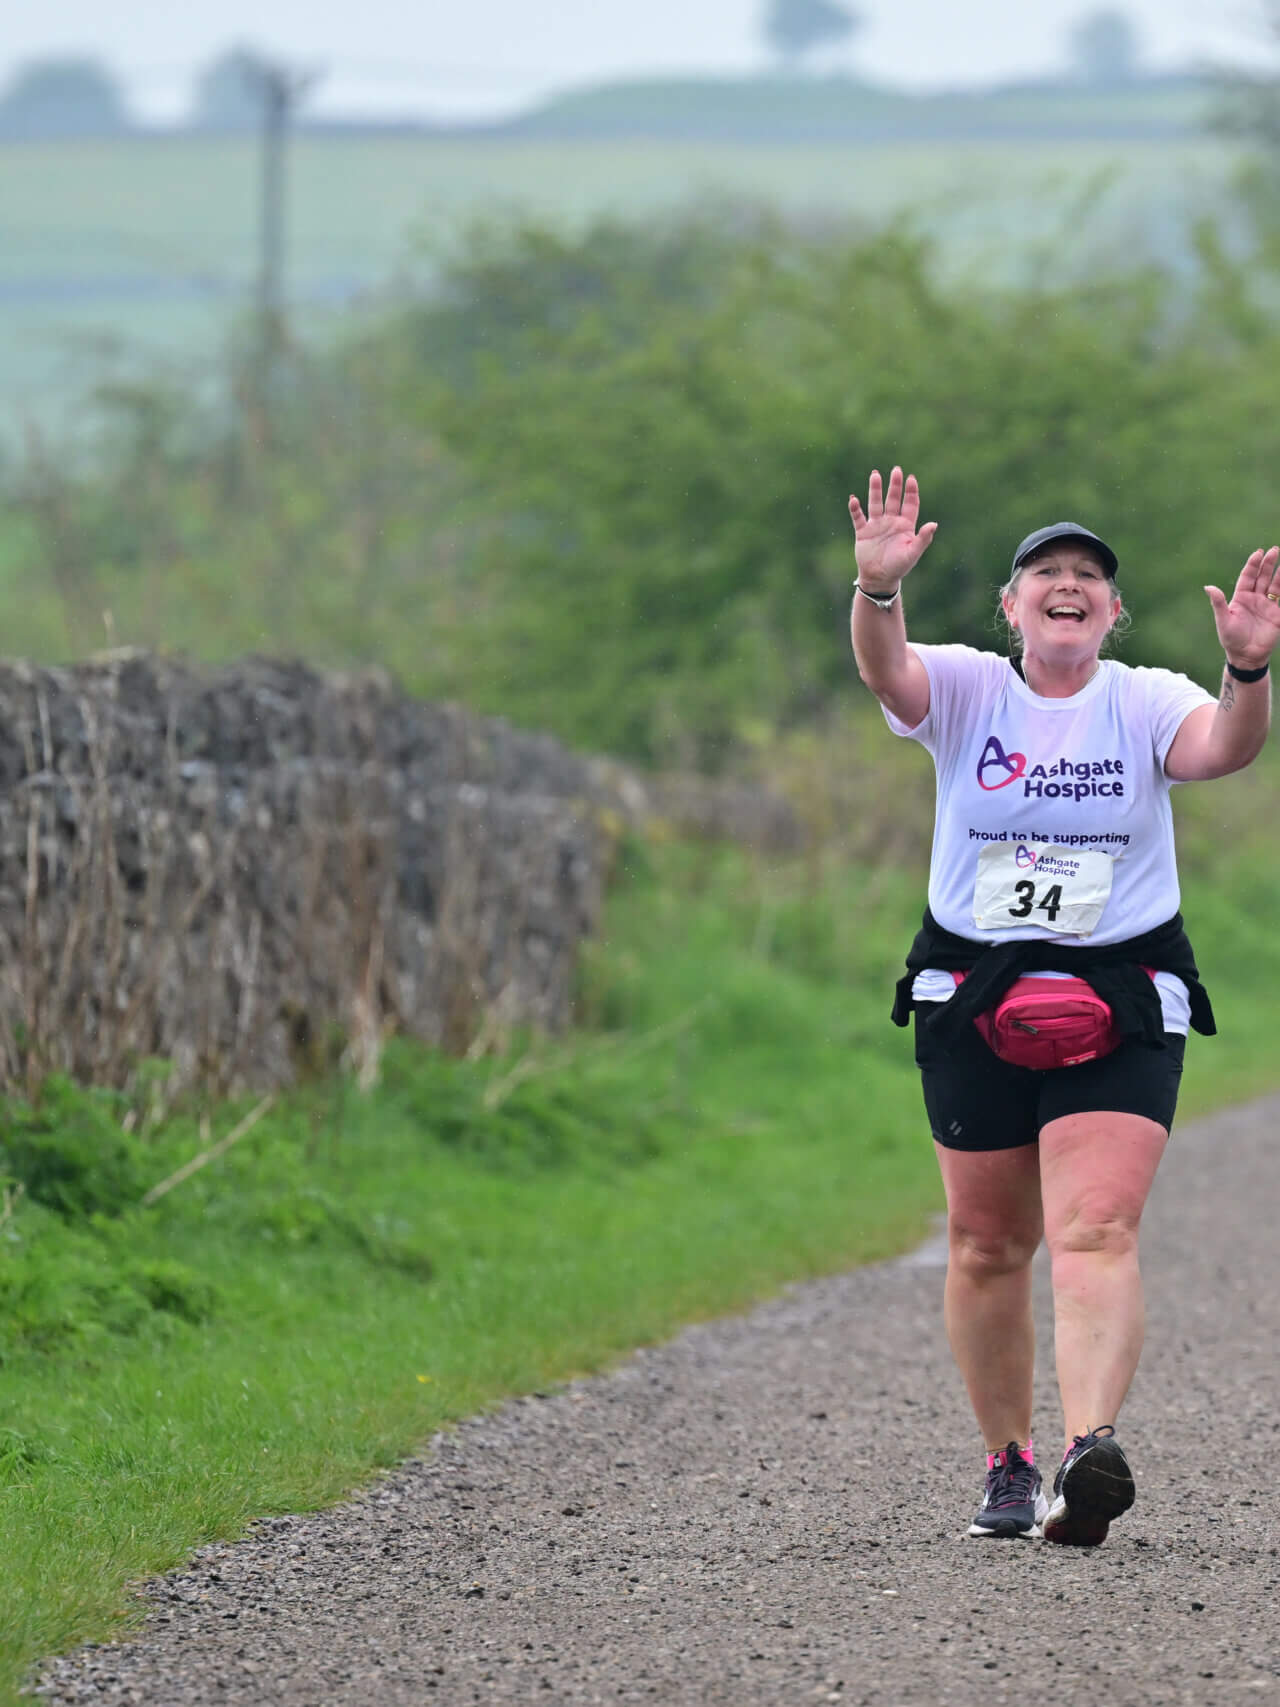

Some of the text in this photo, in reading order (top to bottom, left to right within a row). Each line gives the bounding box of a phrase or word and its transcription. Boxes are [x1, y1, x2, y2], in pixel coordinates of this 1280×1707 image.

[1030, 758, 1124, 780] Ashgate
[1024, 778, 1124, 802] Hospice
[969, 829, 1130, 846] Proud to be supporting
[1034, 863, 1076, 877] Hospice
[1037, 855, 1080, 868] Ashgate
[1008, 880, 1063, 921] 34
